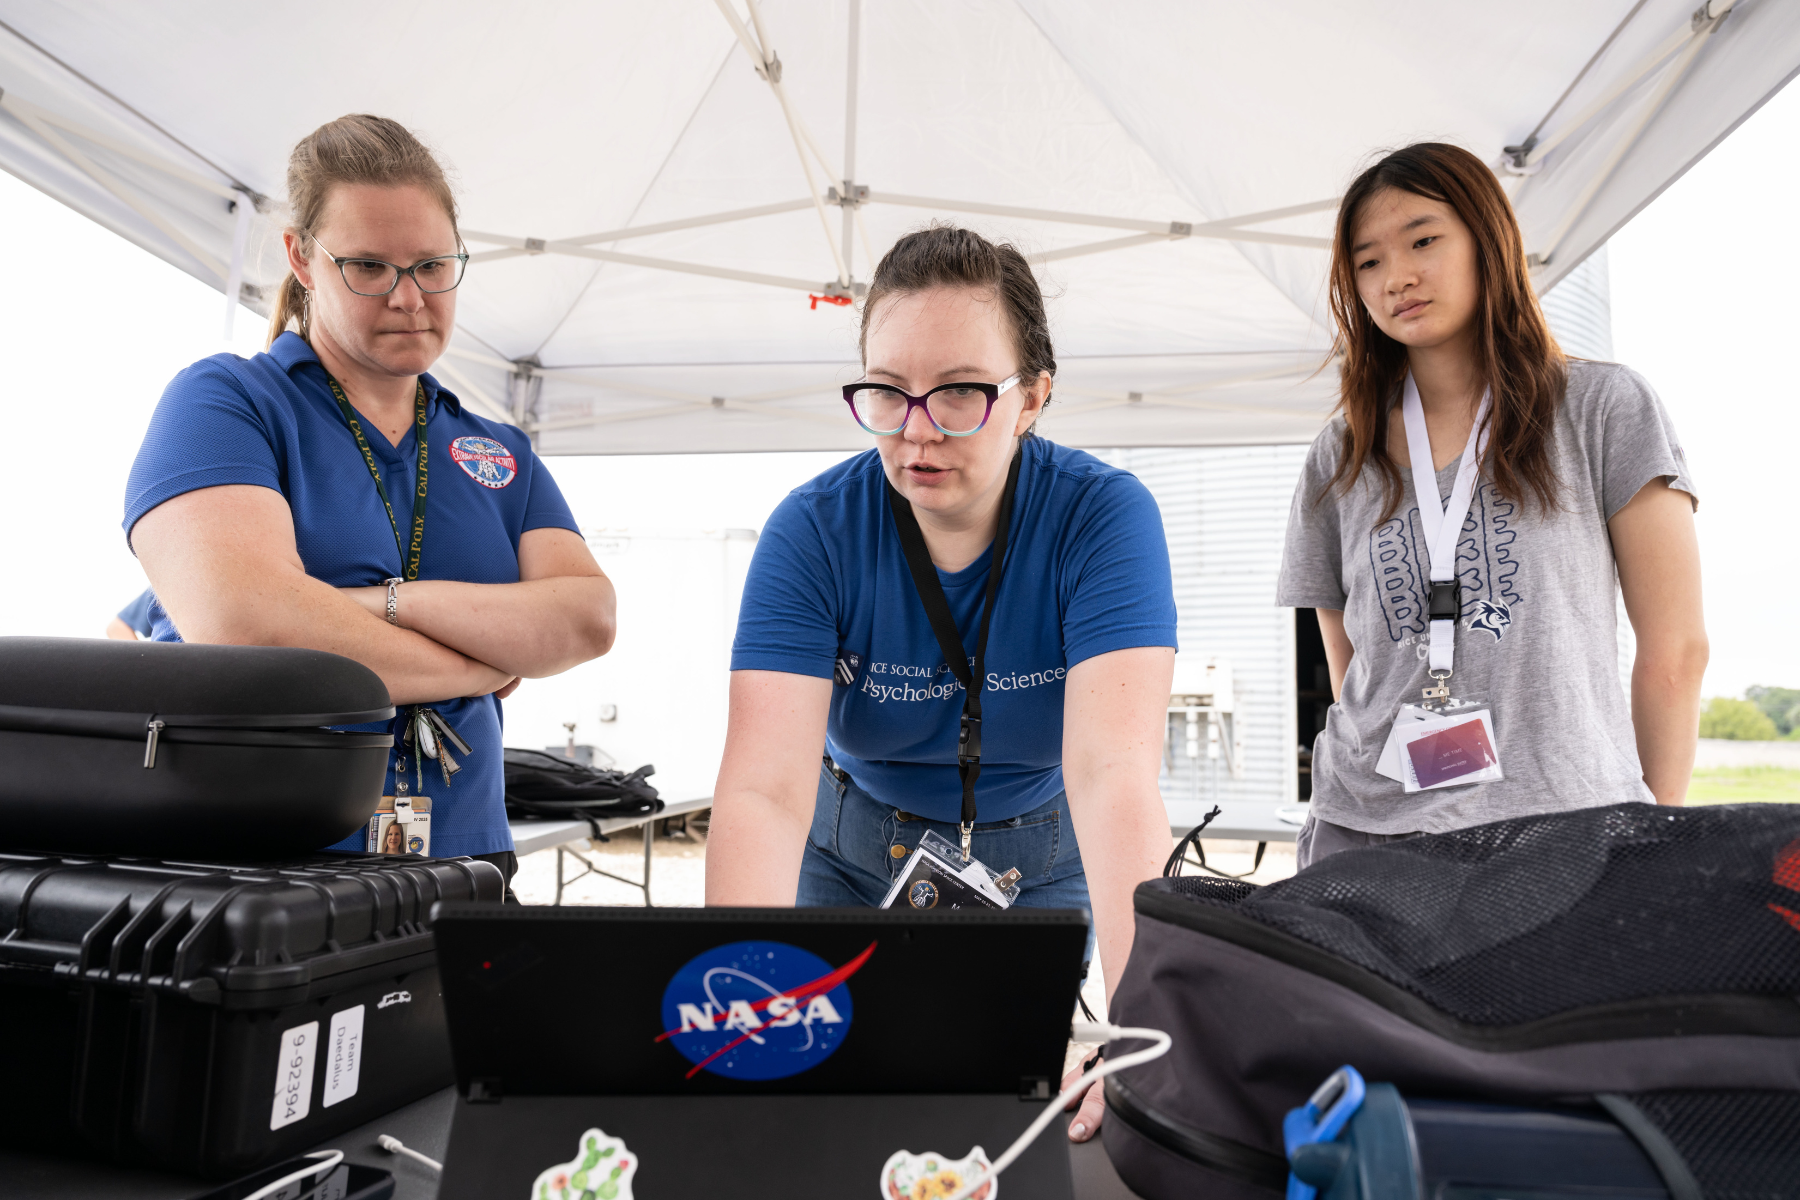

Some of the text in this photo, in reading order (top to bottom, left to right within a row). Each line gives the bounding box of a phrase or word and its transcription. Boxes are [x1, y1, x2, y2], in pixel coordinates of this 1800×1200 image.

[350, 420, 365, 445] CAL
[417, 473, 428, 497] CAL
[407, 553, 420, 580] CAL
[1397, 636, 1417, 650] RICE
[869, 662, 888, 674] ICE
[890, 664, 933, 678] SOCIAL
[861, 675, 966, 703] Psychologic
[676, 994, 844, 1033] NASA
[331, 1026, 347, 1090] Daedalus
[346, 1033, 359, 1073] Team
[284, 1033, 306, 1119] 9-92394
